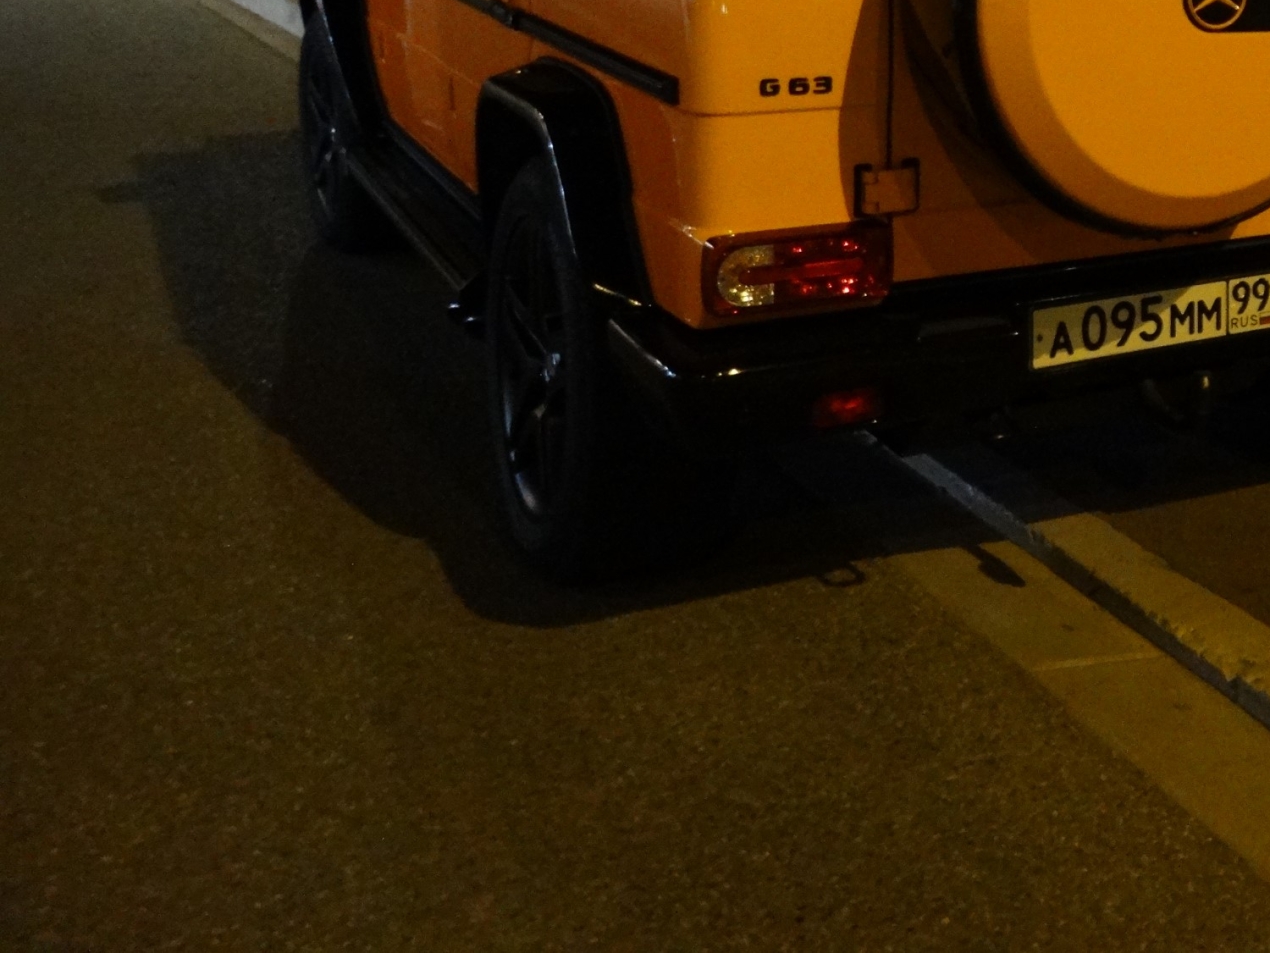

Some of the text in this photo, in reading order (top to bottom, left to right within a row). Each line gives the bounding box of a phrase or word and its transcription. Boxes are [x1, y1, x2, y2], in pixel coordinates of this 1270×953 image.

[759, 75, 832, 97] G 63
[1232, 278, 1270, 315] 99
[1230, 314, 1259, 330] RUS
